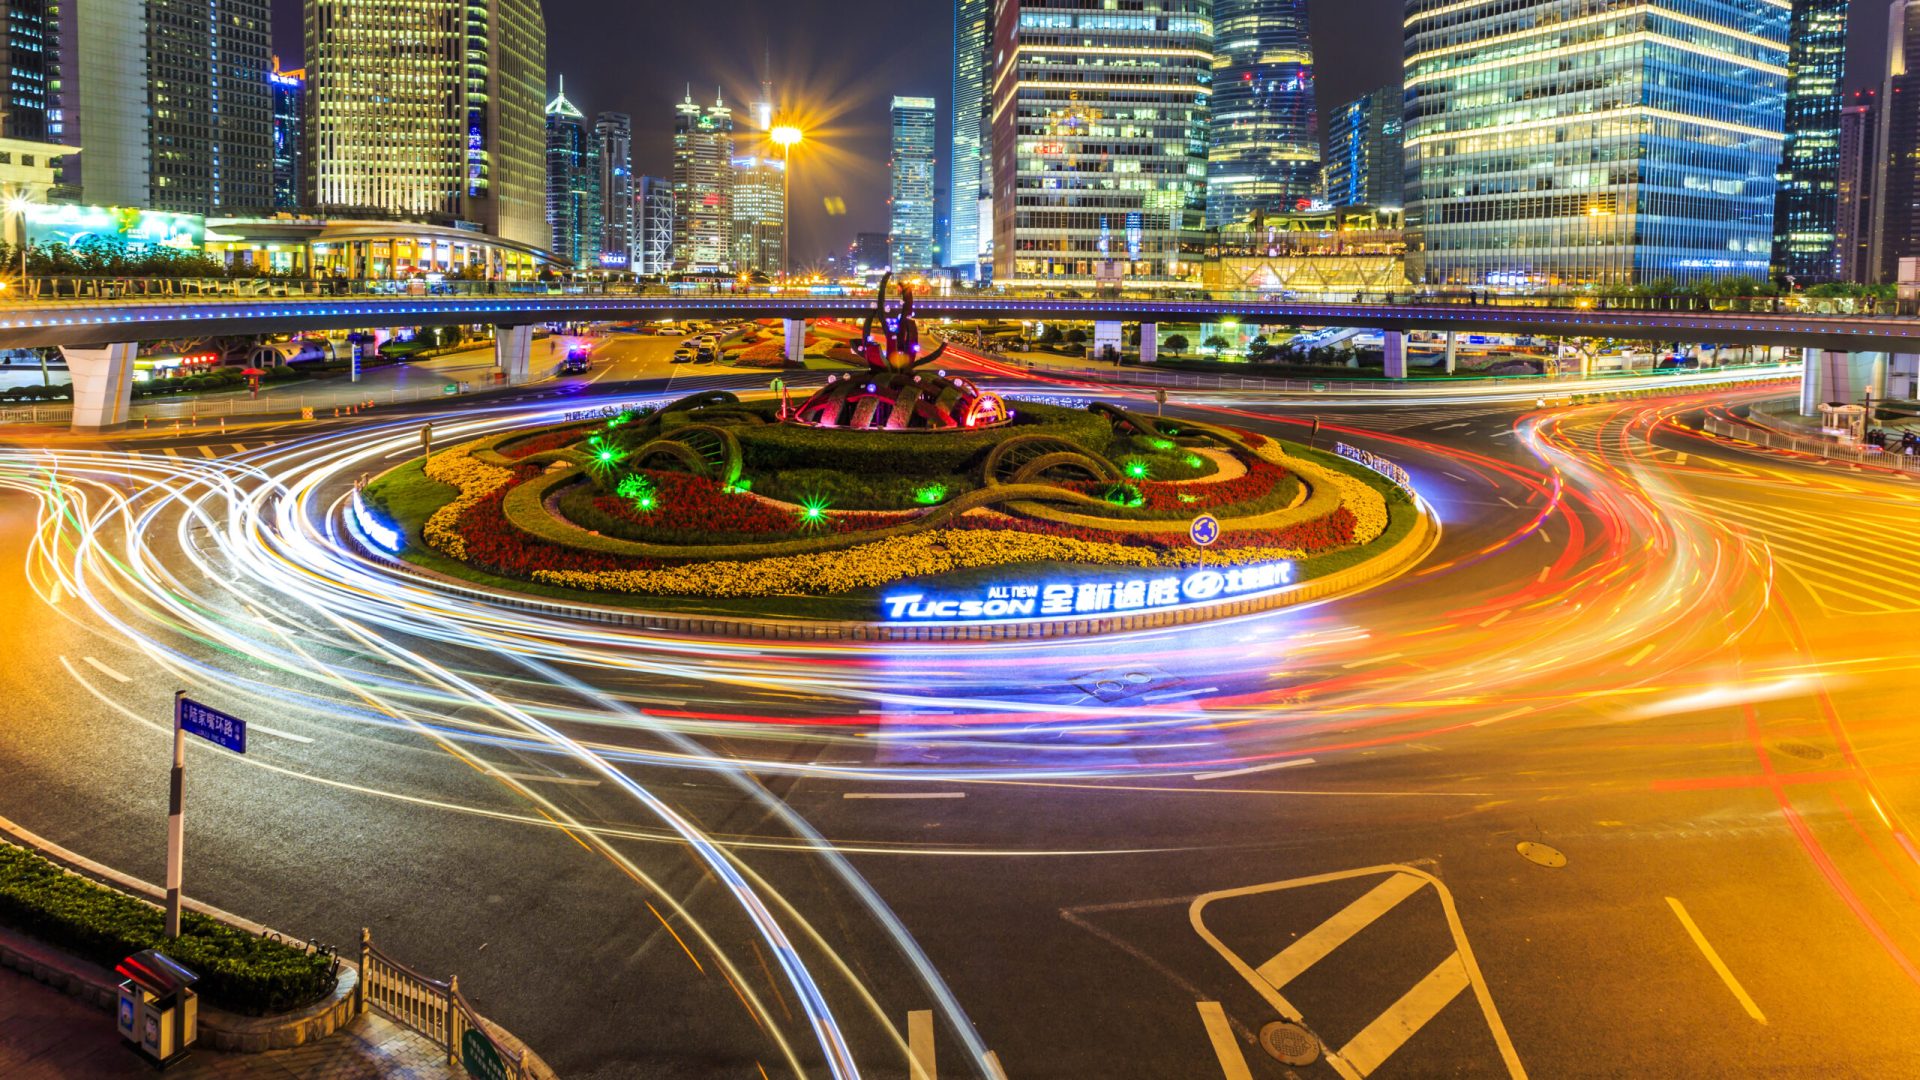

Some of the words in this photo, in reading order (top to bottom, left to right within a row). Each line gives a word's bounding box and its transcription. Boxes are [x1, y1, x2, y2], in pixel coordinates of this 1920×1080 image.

[988, 586, 1009, 599] ALL
[1041, 576, 1180, 613] 全新途胜
[885, 594, 1034, 617] TUCSON
